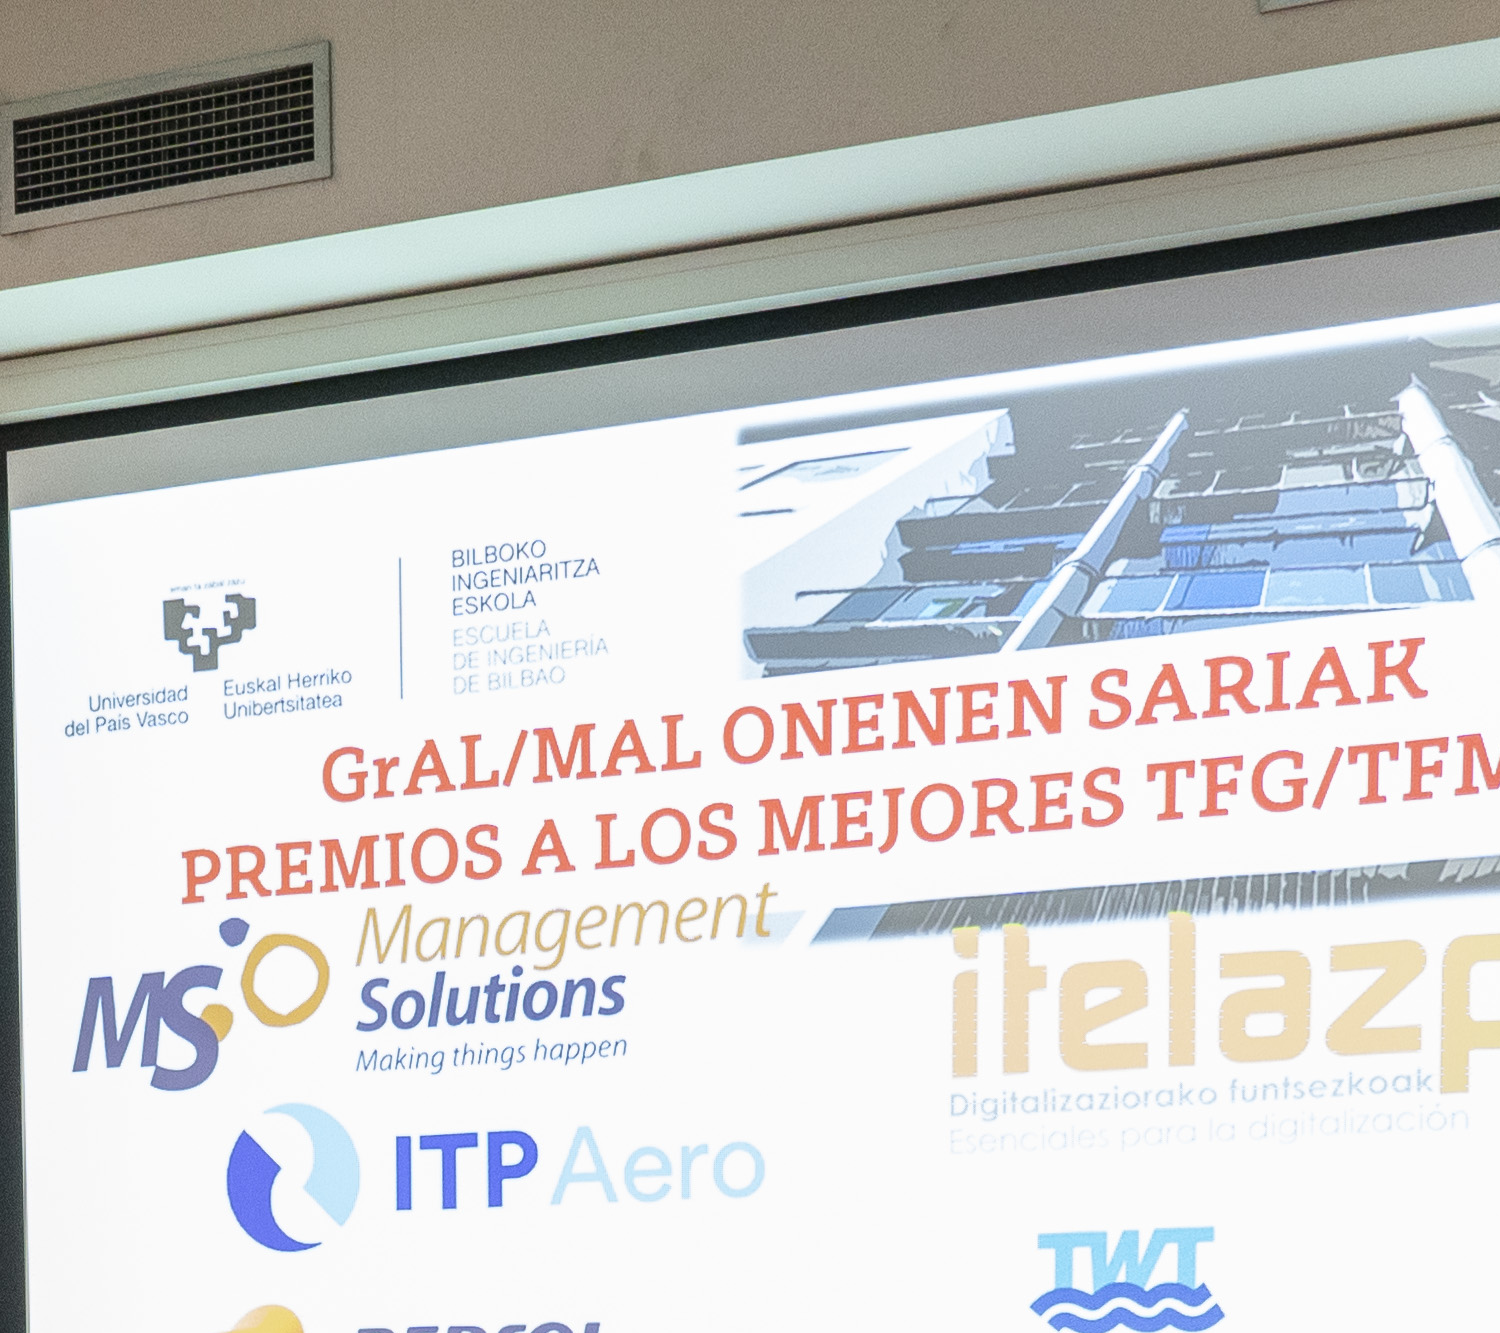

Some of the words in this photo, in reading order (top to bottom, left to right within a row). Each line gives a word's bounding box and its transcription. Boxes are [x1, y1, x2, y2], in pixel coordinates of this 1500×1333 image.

[450, 539, 547, 568] BILBOKO
[450, 556, 601, 592] INGENIARITZA
[450, 589, 537, 615] ESKOLA
[450, 619, 551, 647] ESCUELA
[451, 651, 482, 671] DE
[487, 635, 610, 666] INGENIERÍA
[222, 672, 282, 698] Euskal
[287, 667, 353, 693] Herriko
[451, 674, 481, 696] DE
[487, 664, 567, 692] BILBAO
[87, 686, 189, 713] Universidad
[222, 691, 344, 721] Unibertsitatea
[63, 713, 92, 738] del
[96, 712, 132, 734] País
[136, 708, 190, 730] Vasco
[321, 714, 703, 803] GrAL/MAL
[722, 673, 1068, 766] ONENEN
[1088, 635, 1429, 731] SARIAK
[181, 823, 504, 906] PREMIOS
[522, 821, 575, 878] A
[596, 804, 738, 870] LOS
[757, 764, 1126, 859] MEJORES
[355, 882, 779, 971] Management
[356, 965, 627, 1033] Solutions
[355, 1045, 446, 1075] Making
[451, 1041, 527, 1067] things
[534, 1036, 628, 1064] happen
[948, 1084, 1221, 1123] Digitalizaziorako
[1227, 1066, 1435, 1106] funtsezkoak
[948, 1121, 1111, 1156] Esenciales
[1119, 1121, 1198, 1151] para
[1205, 1115, 1240, 1142] la
[1247, 1104, 1472, 1142] digitalización
[395, 1129, 540, 1211] ITP
[550, 1124, 768, 1206] Aero
[1036, 1225, 1216, 1294] TWT
